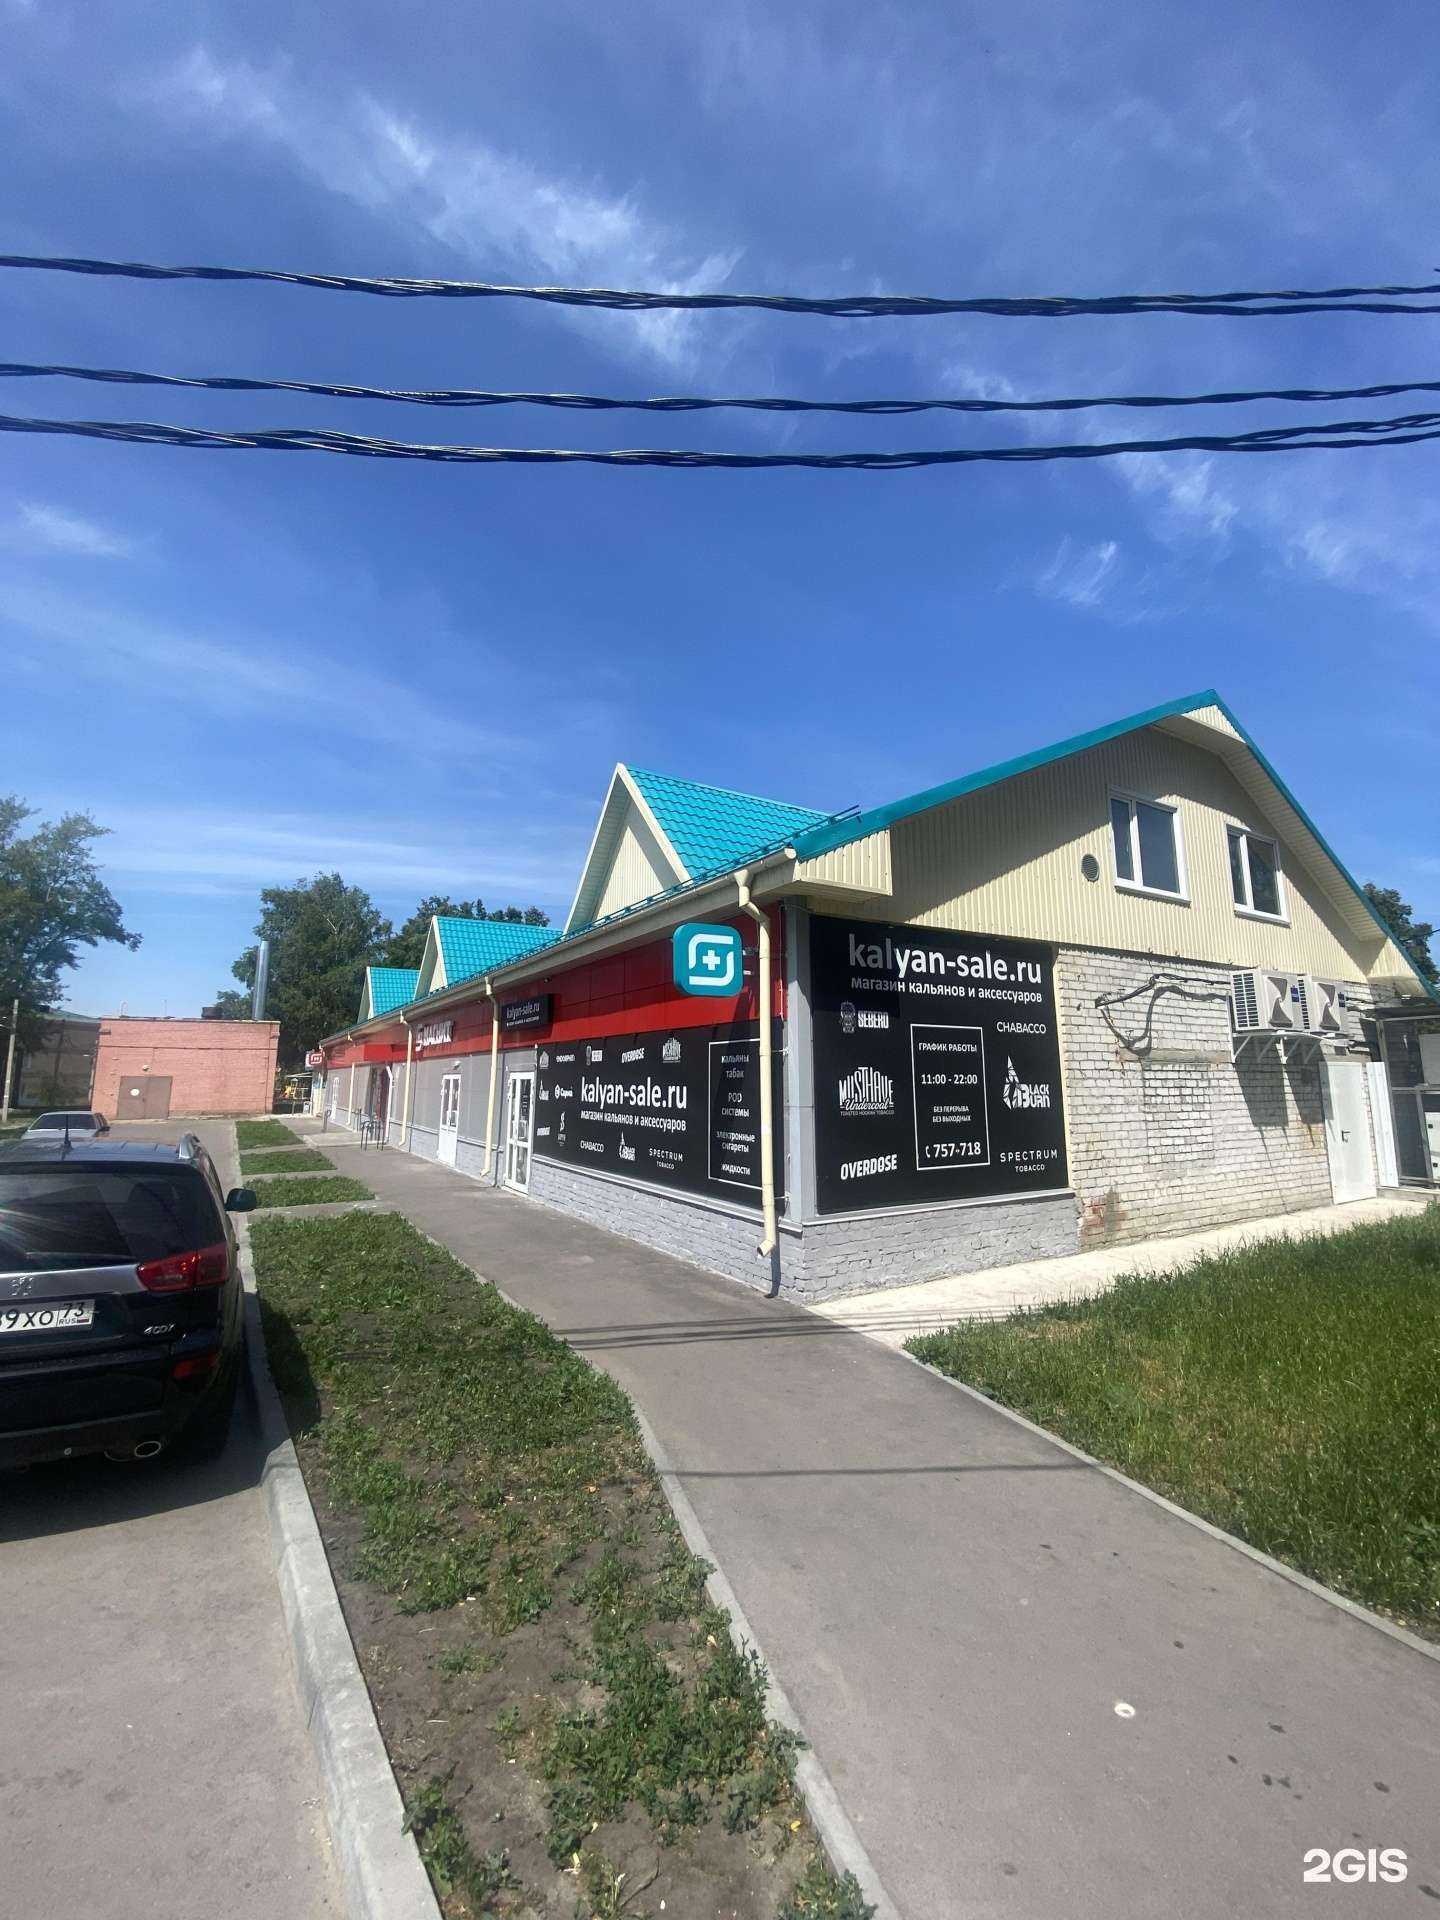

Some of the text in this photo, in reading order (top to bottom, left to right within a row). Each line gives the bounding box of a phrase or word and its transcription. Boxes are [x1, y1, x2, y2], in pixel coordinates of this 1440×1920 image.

[849, 933, 1042, 984] kalyan-sale.ru
[851, 977, 1043, 1005] магазин кальянов и аксессуаров
[996, 1021, 1047, 1035] CHABACCO
[919, 1042, 978, 1053] ГРАФИК РАБОТЫ
[838, 1066, 894, 1106] MUSTHAVE
[921, 1074, 947, 1085] 11:00
[953, 1074, 978, 1085] 22:00
[581, 1075, 687, 1110] kalyan-sale.ru
[721, 1106, 750, 1118] системы
[943, 1105, 970, 1113] ПЕРЕРЫВА
[580, 1110, 687, 1134] магазин кальянов и аксессуаров
[649, 1147, 683, 1162] SPECTRUM
[999, 1149, 1058, 1163] SPECTRUM
[840, 1153, 898, 1180] OVERDOSE
[1015, 1163, 1046, 1173] TOBACCO
[61, 1302, 86, 1319] 73
[58, 1318, 77, 1326] RUS
